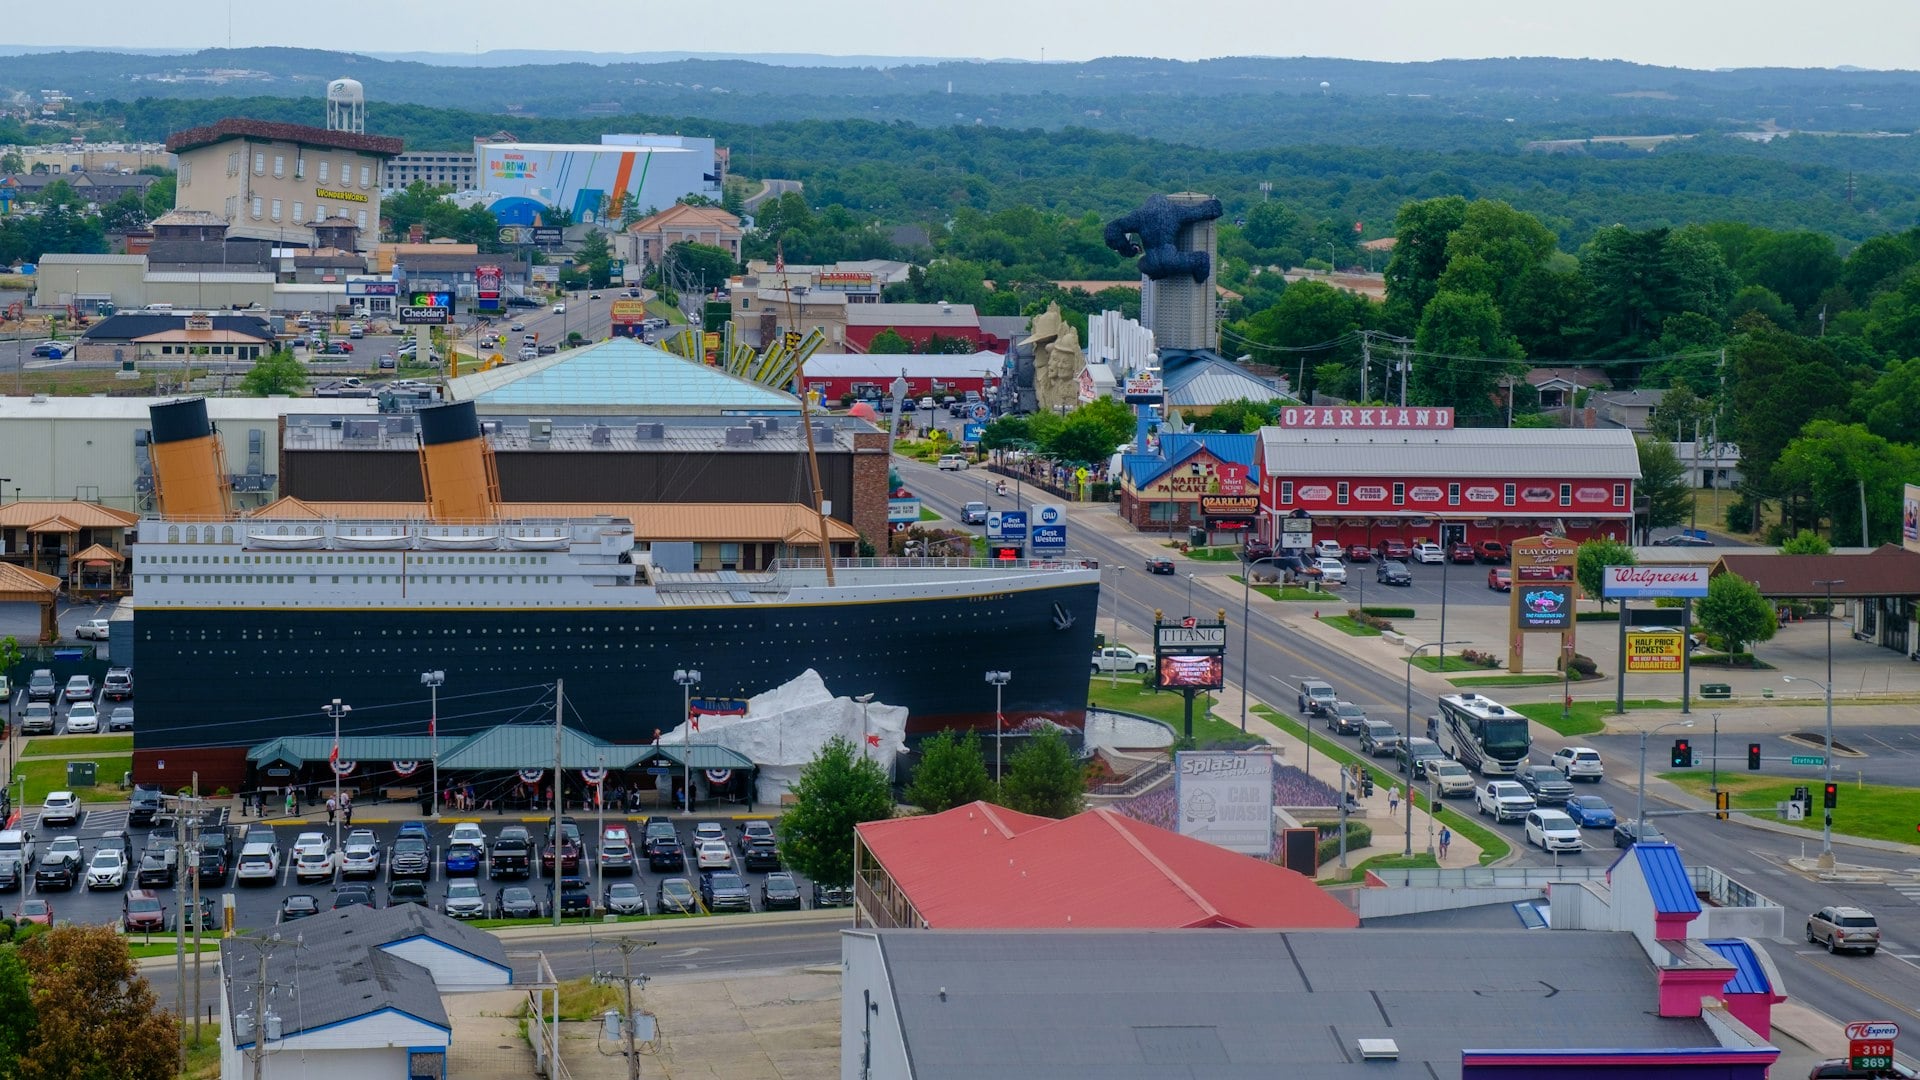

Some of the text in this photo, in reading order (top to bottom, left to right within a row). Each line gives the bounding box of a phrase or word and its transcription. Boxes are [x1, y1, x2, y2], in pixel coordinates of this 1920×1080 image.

[491, 161, 537, 171] BOARDWALK
[402, 308, 445, 317] Cheddar's
[1285, 409, 1449, 426] OZARKLAND
[1228, 467, 1238, 478] T
[1172, 477, 1208, 485] WAFFLE
[1203, 498, 1259, 507] OZARKLAND
[1043, 512, 1057, 520] BW
[1041, 529, 1057, 537] Best
[1615, 567, 1699, 587] Walgreens
[969, 594, 1004, 602] TITANIC
[1639, 589, 1673, 597] pharmacy
[1160, 630, 1223, 642] TITANIC
[1631, 661, 1680, 669] GUARANTEED!
[705, 701, 732, 710] TITANIC
[1182, 756, 1246, 775] Splash
[1228, 787, 1260, 803] CAR
[1218, 805, 1268, 821] WASH
[1851, 1024, 1896, 1039] 76 Express
[1863, 1045, 1886, 1055] 319
[1862, 1058, 1885, 1068] 369
